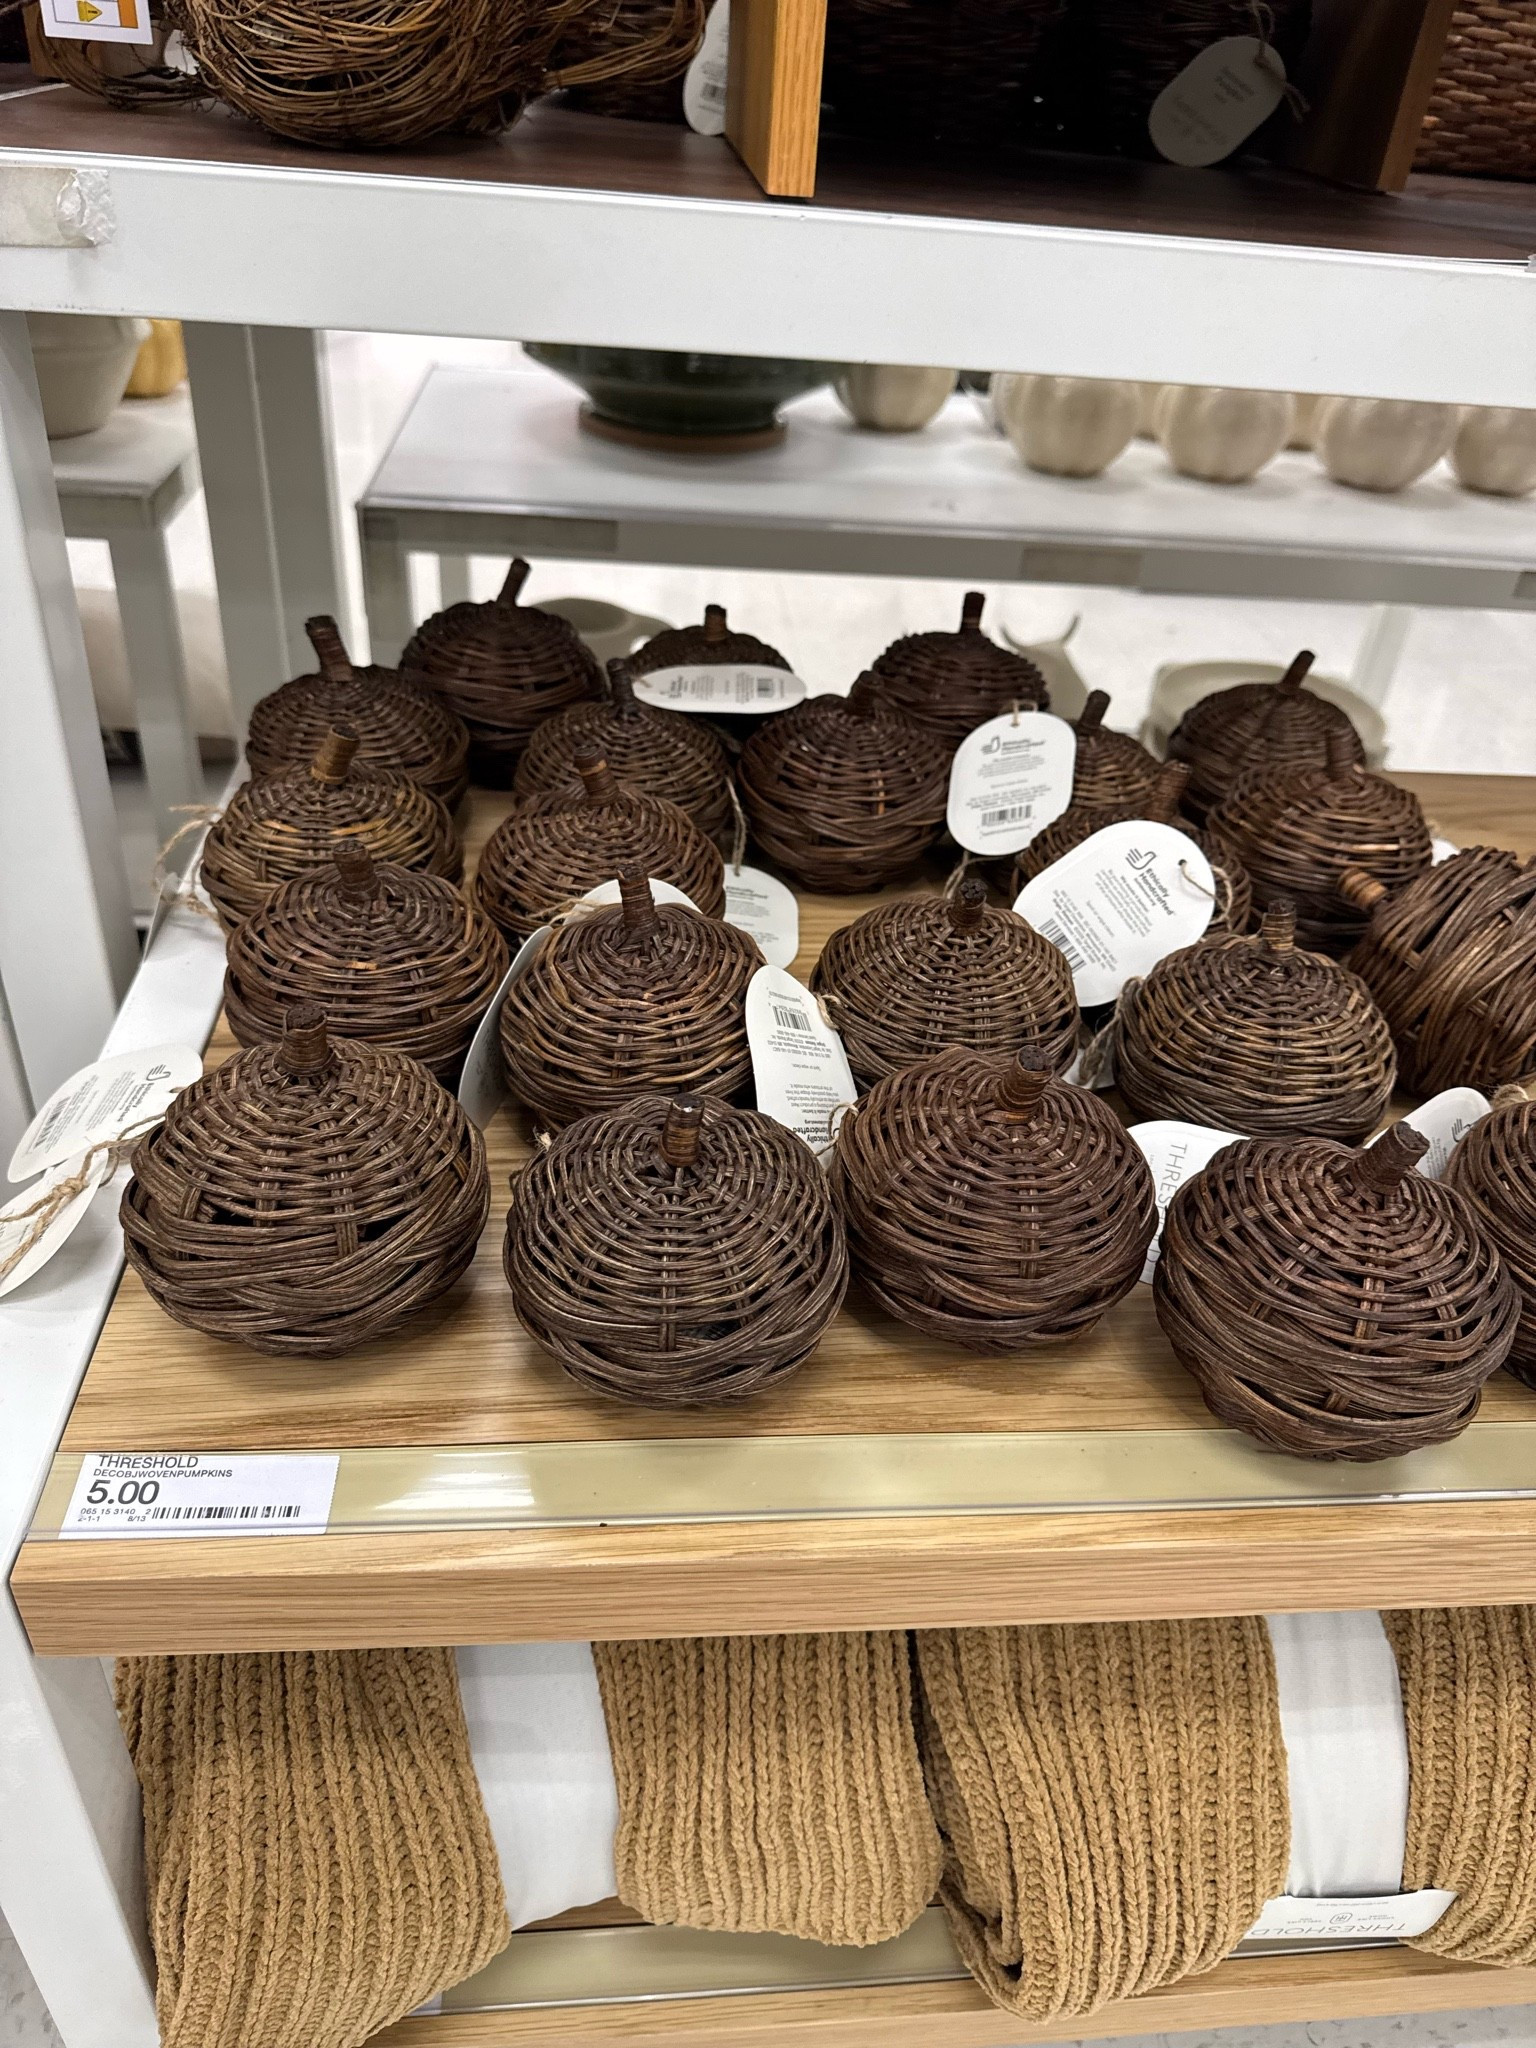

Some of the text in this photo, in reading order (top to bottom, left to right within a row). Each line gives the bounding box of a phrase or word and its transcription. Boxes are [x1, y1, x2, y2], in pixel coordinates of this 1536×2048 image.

[1144, 867, 1170, 898] Ethically
[1138, 872, 1174, 916] Handcrafted
[806, 1134, 828, 1143] thically
[98, 1455, 199, 1468] THRESHOLD
[93, 1468, 233, 1478] DECOBJWOVENPUMPKINS
[86, 1479, 160, 1505] 5.00
